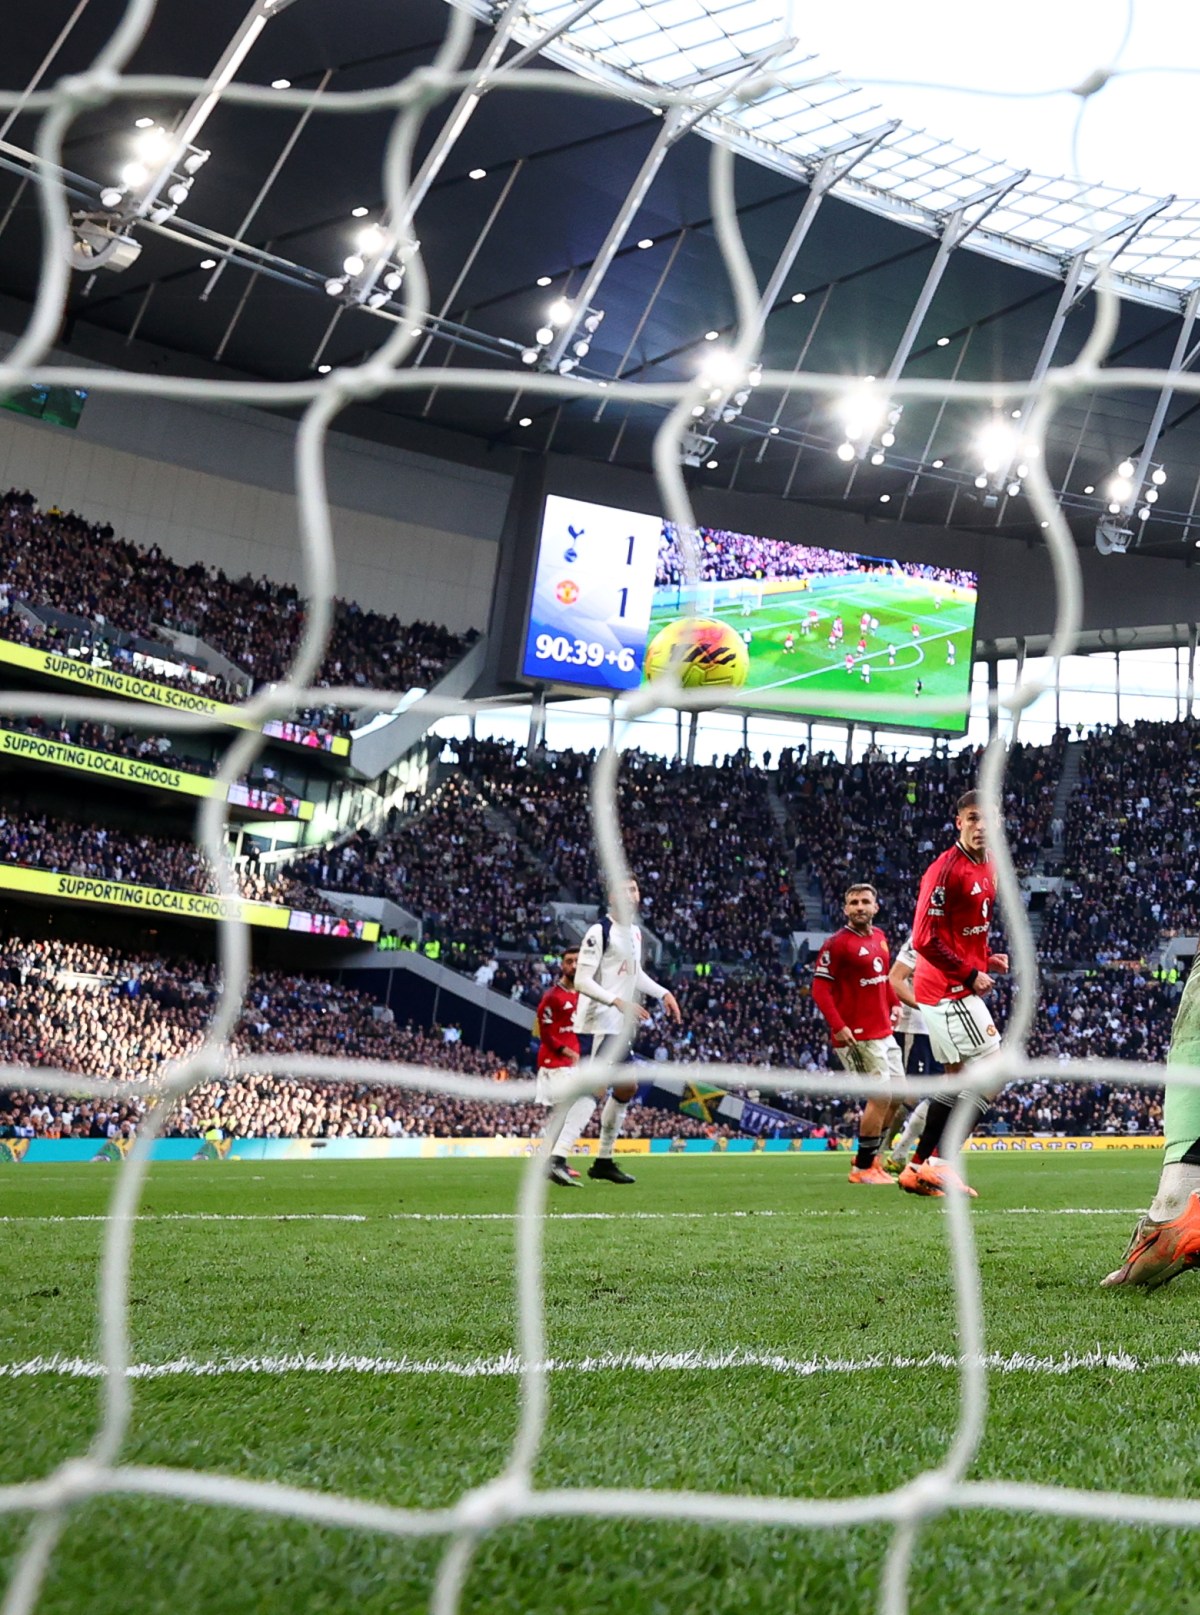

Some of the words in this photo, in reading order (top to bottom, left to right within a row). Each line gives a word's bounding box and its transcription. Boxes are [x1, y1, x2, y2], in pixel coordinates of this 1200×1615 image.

[625, 536, 635, 566] 1
[616, 587, 629, 618] 1
[44, 656, 124, 690] SUPPORTING
[125, 679, 163, 702] LOCAL
[165, 691, 217, 715] SCHOOLS
[3, 735, 85, 765] SUPPORTING
[87, 755, 125, 775] LOCAL
[127, 764, 182, 787] SCHOOLS
[58, 877, 143, 904] SUPPORTING
[145, 891, 185, 911] LOCAL
